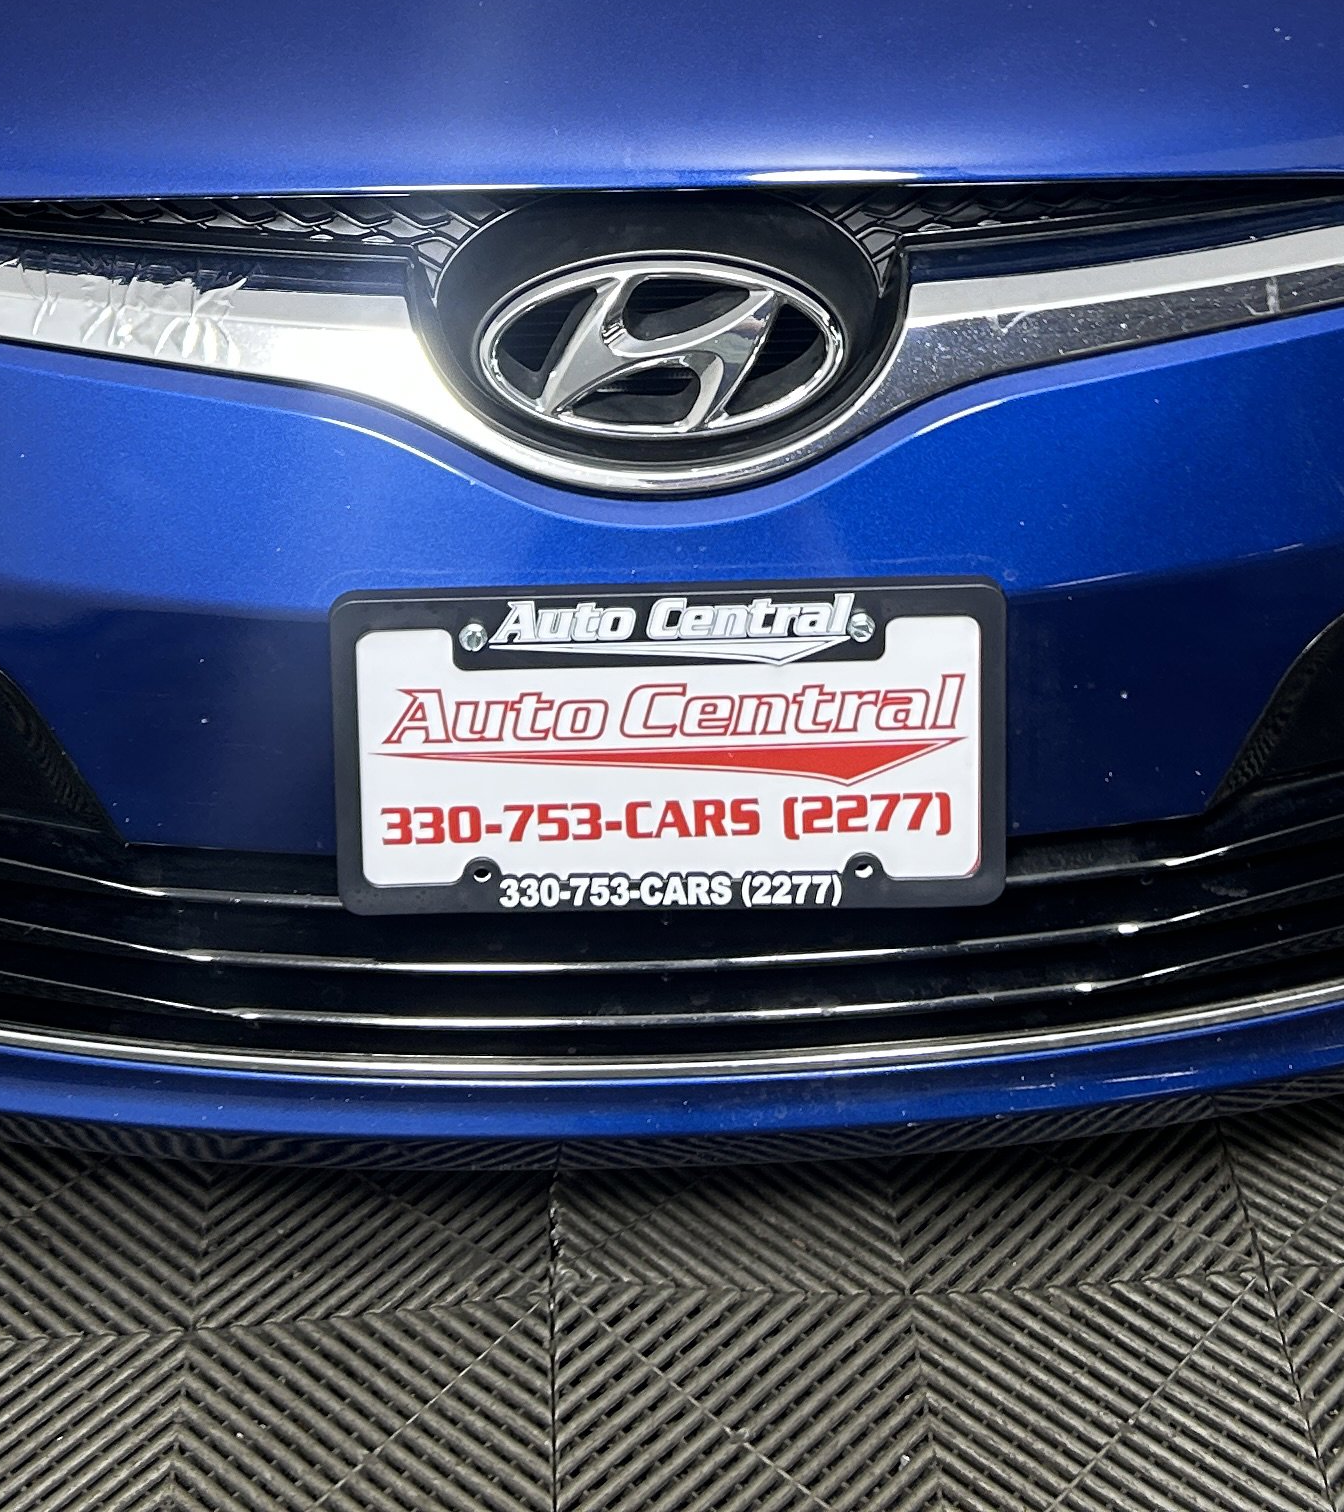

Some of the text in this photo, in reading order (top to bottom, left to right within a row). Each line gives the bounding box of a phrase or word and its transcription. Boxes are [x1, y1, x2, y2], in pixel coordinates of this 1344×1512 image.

[488, 593, 855, 643] Auto Central
[381, 674, 966, 744] Auto Central
[380, 791, 952, 845] 330-753-CARS (2277)
[499, 873, 843, 907] 330-753-CARS (2277)
